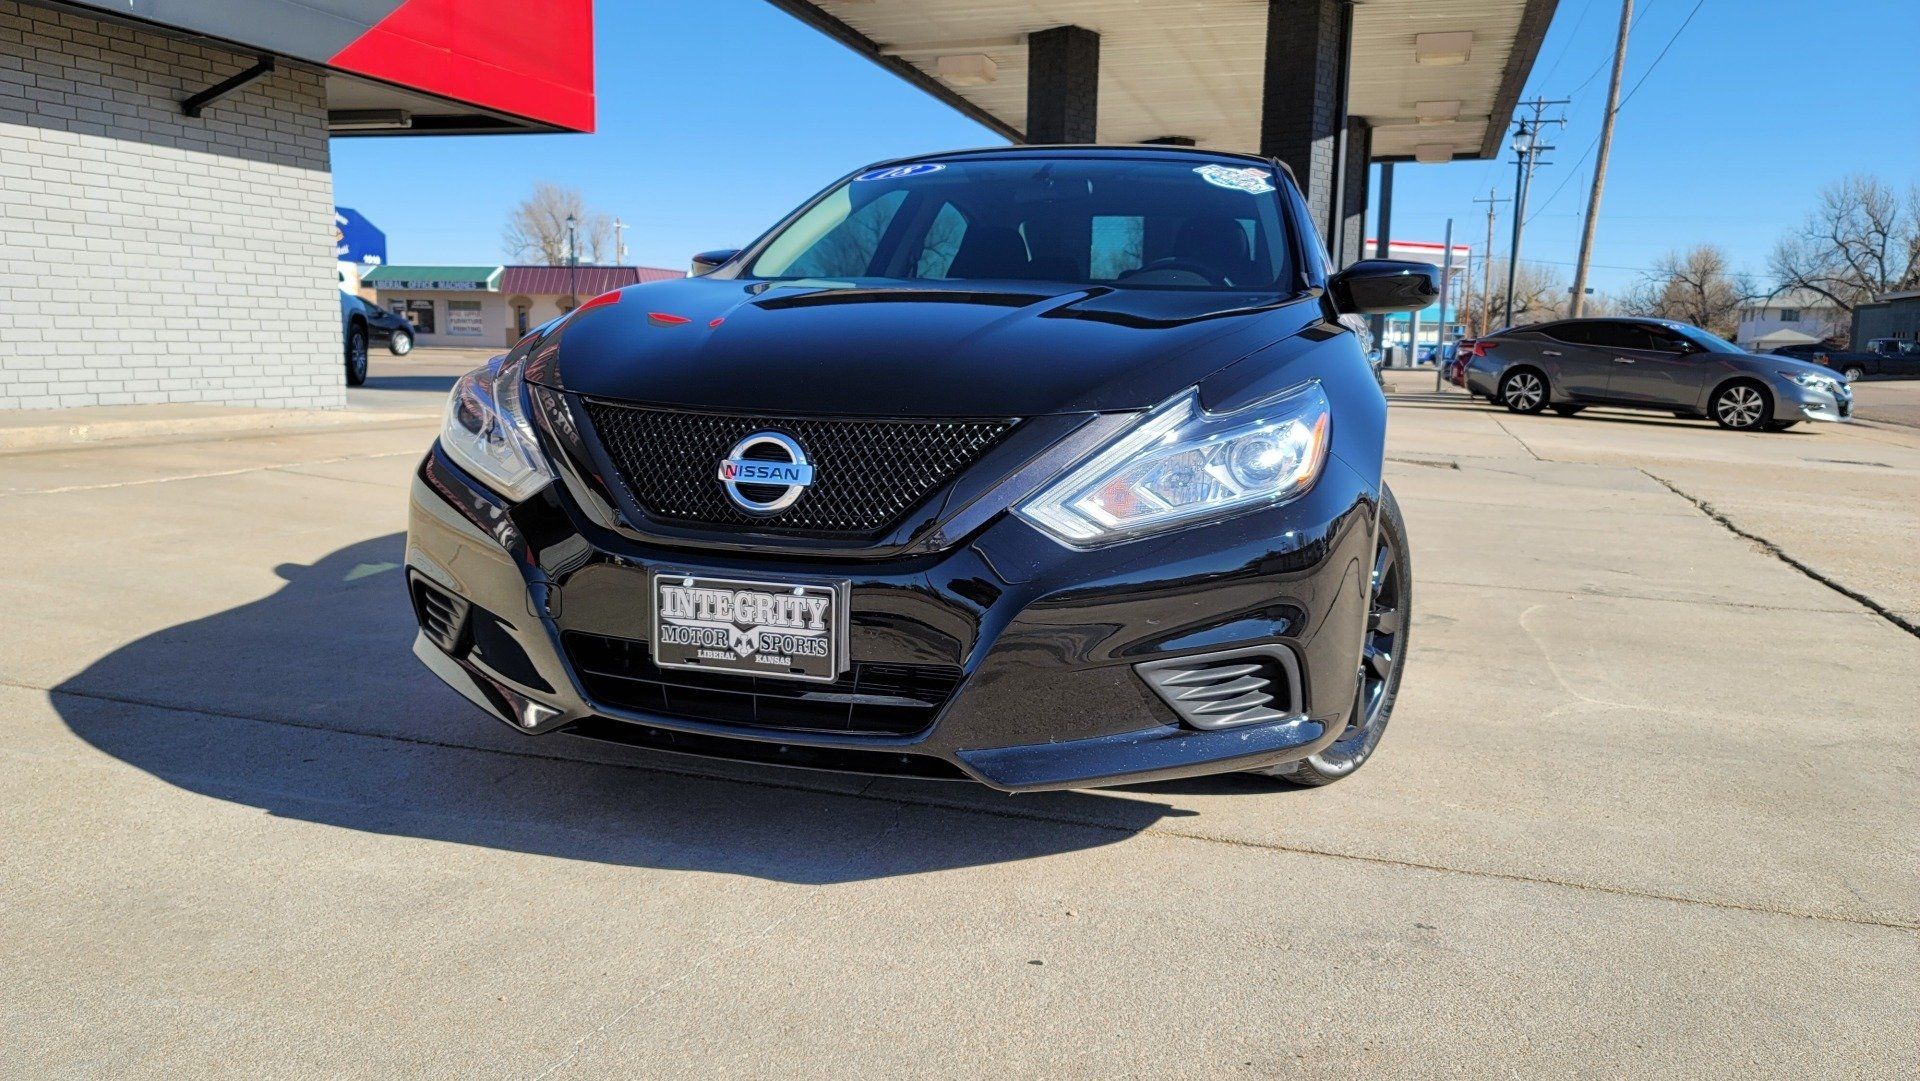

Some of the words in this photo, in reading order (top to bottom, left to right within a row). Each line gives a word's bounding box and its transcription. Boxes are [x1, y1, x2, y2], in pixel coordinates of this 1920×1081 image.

[373, 280, 404, 289] LIBERAL
[407, 281, 433, 289] OFFICE
[438, 281, 477, 290] MACHINES
[725, 464, 800, 480] NISSAN
[660, 585, 829, 630] INTEGRITY
[661, 625, 730, 649] MOTOR
[760, 632, 829, 657] SPORTS
[697, 649, 737, 661] LIBERAL
[754, 654, 792, 667] KANSAS
